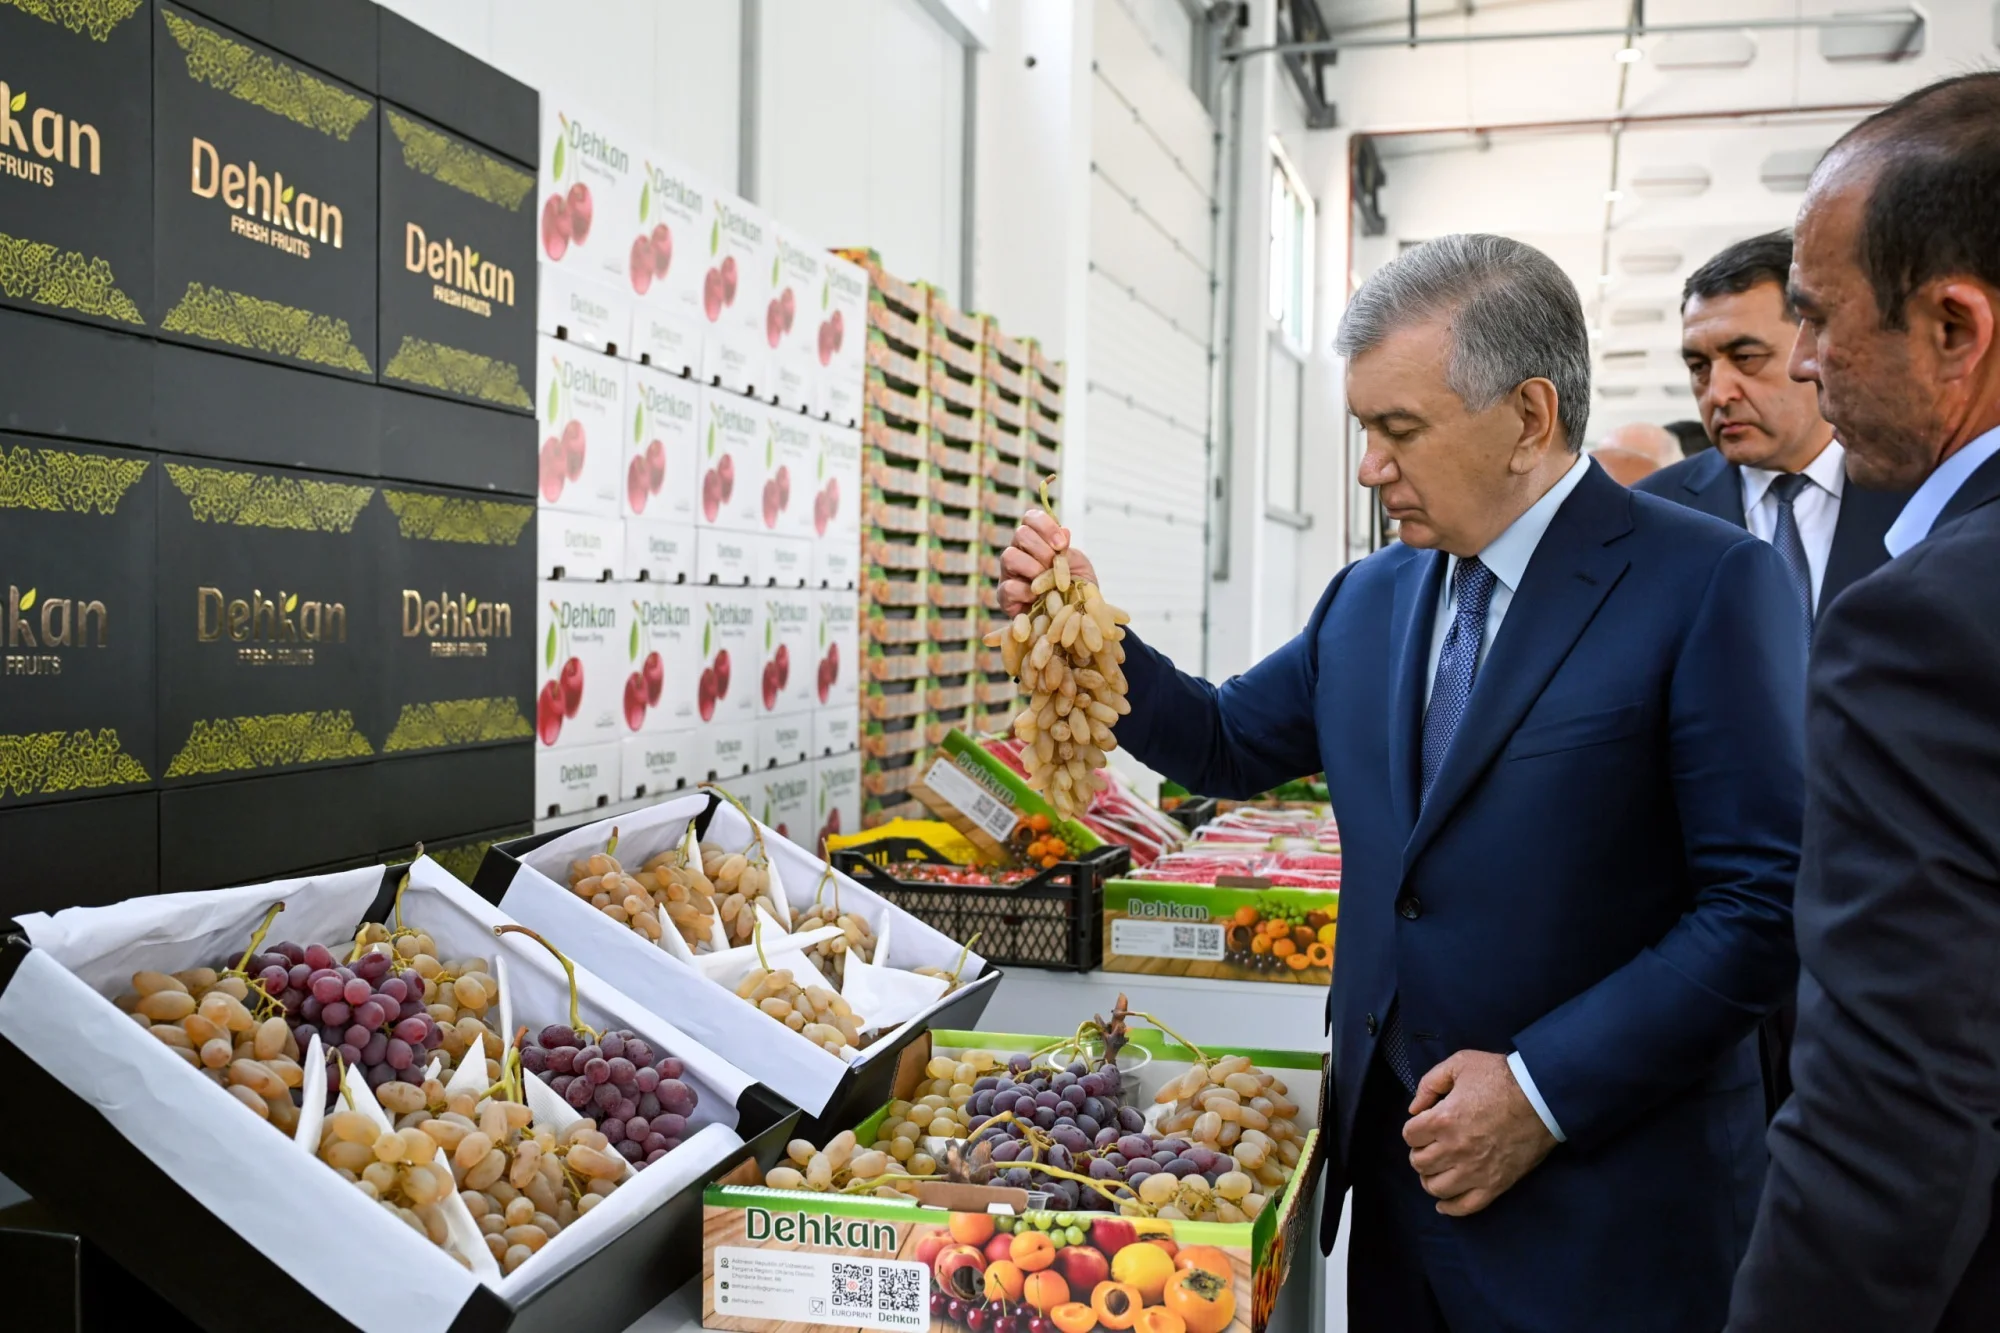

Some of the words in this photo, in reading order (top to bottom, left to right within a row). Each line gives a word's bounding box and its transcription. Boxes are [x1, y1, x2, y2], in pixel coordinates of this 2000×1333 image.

[569, 119, 629, 175] Dehkan
[191, 136, 343, 249] Dehkan
[653, 167, 703, 215] Dehkan
[231, 214, 269, 244] FRESH
[270, 229, 310, 259] FRUITS
[405, 221, 515, 306] Dehkan
[562, 361, 617, 401] Dehkan
[646, 386, 692, 421] Dehkan
[0, 584, 108, 648] kan
[197, 586, 346, 643] Dehkan
[402, 588, 512, 638] Dehkan
[560, 601, 616, 629] Dehkan
[641, 600, 690, 626] Dehkan
[713, 602, 753, 626] Dehkan
[5, 655, 61, 675] FRUITS
[559, 763, 598, 784] Dehkan
[956, 750, 1016, 805] Dehkan
[1127, 898, 1209, 921] Dehkan
[747, 1207, 896, 1251] Dehkan
[832, 1308, 872, 1319] EUROPRINT
[878, 1312, 920, 1325] Dehkan
